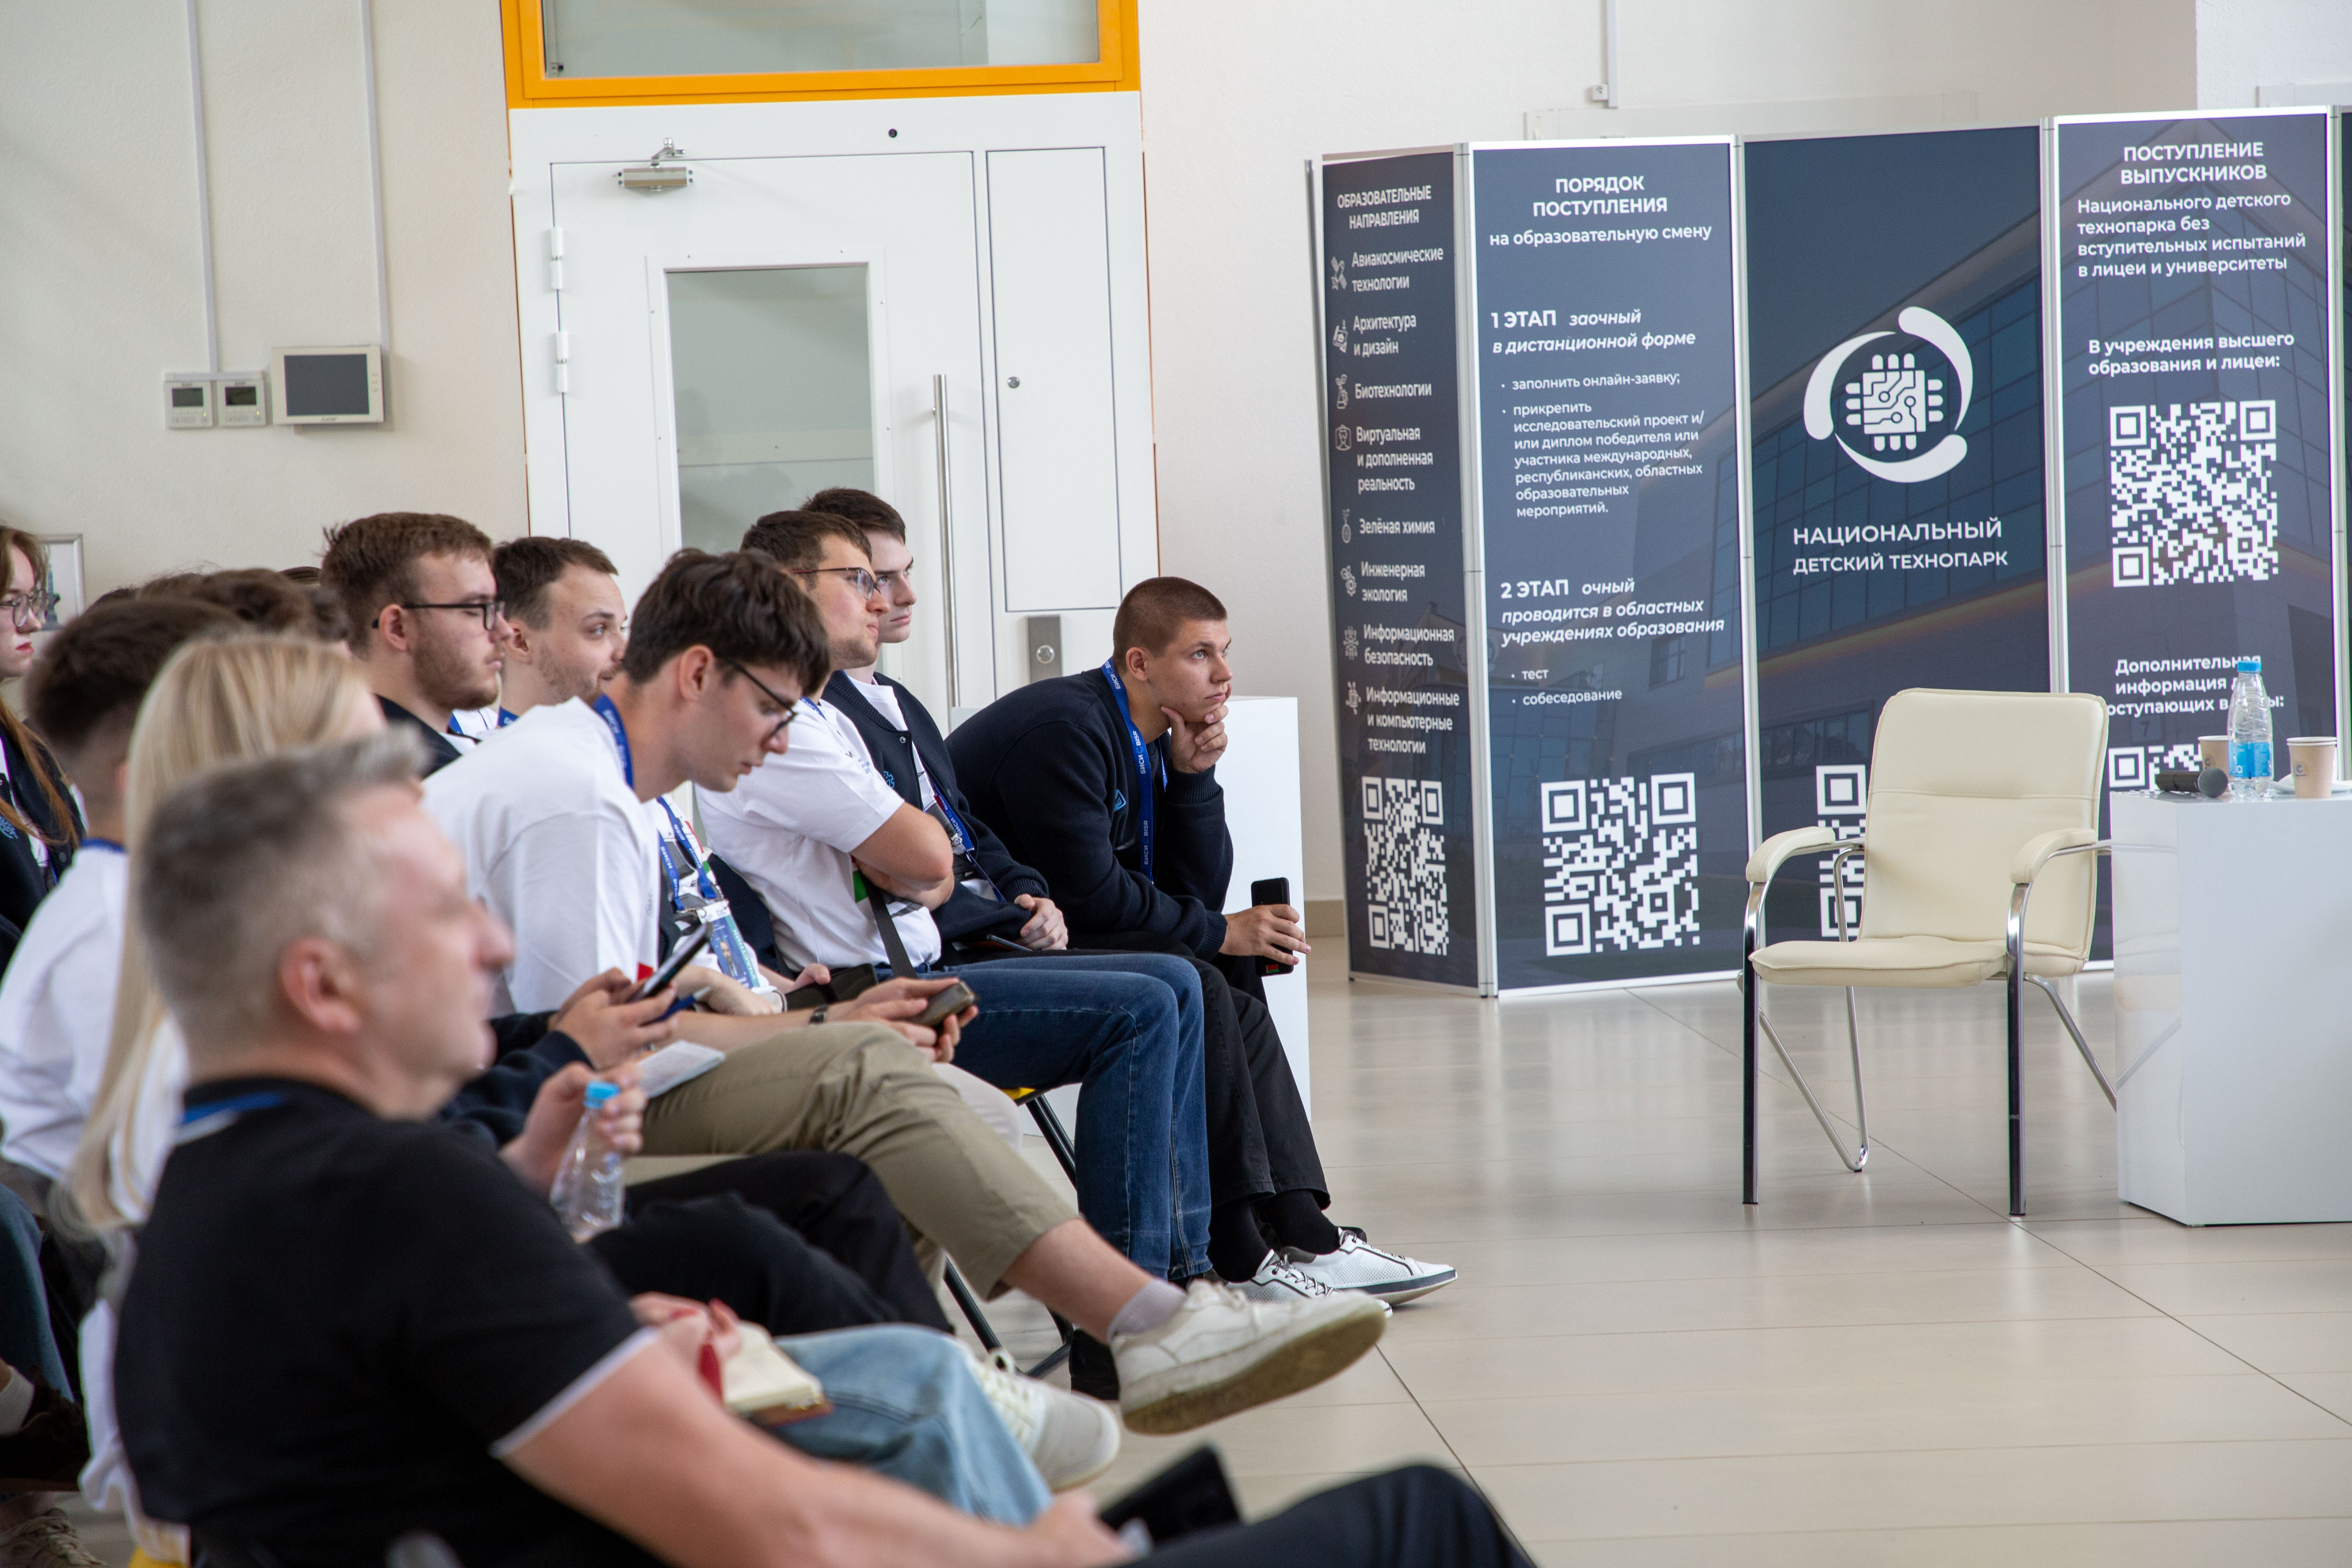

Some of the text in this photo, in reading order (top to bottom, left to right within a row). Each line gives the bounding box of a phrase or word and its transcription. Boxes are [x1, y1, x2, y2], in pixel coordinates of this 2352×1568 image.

[2124, 142, 2263, 162] ПОСТУПЛЕНИЕ
[2121, 165, 2267, 184] ВЫПУСКНИКОВ
[1556, 175, 1645, 194] ПОРЯДОК
[1337, 185, 1432, 208] ОБРАЗОВАТЕЛЬНЫЕ
[2078, 194, 2291, 214] Национального детского
[1533, 197, 1667, 217] ПОСТУПЛЕНИЯ
[1349, 208, 1419, 229] НАПРАВЛЕНИЯ
[2077, 215, 2210, 236] технопарка без
[1490, 226, 1712, 248] на образовательную смену
[2078, 233, 2306, 258] вступительных испытаний
[1352, 248, 1444, 267] Авиакосмические
[2079, 257, 2287, 278] в лицеи и университеты
[1352, 276, 1409, 292] технологии
[1353, 315, 1417, 334] Архитектура
[1491, 308, 1642, 328] 1 ЭТАП заочный
[1354, 338, 1399, 357] и дизайн
[1493, 332, 1696, 355] в дистанционной форме
[2089, 334, 2294, 357] В учреждения высшего
[2089, 356, 2280, 377] образования и лицеи:
[1355, 383, 1432, 399] Биотехнологии
[1512, 373, 1680, 390] заполнить онлайн-заявку;
[1513, 403, 1592, 418] прикрепить
[1514, 410, 1705, 432] исследовательский проект и/
[1356, 426, 1421, 445] Виртуальная
[1514, 431, 1699, 450] или диплом победителя или
[1357, 452, 1433, 468] и дополненная
[1514, 448, 1692, 469] участника международных,
[1516, 464, 1703, 486] республиканских, областных
[1358, 478, 1415, 494] реальность
[1516, 486, 1629, 502] образовательных
[1516, 501, 1608, 519] мероприятий.
[1359, 518, 1435, 534] Зелёная химия
[1794, 517, 2002, 546] НАЦИОНАЛЬНЫЙ
[1361, 562, 1425, 581] Инженерная
[1793, 551, 2008, 575] ДЕТСКИЙ ТЕХНОПАРК
[1362, 589, 1408, 602] экология
[1501, 578, 1635, 599] 2 ЭТАП очный
[1502, 600, 1704, 626] проводится в областных
[1364, 624, 1455, 643] Информационная
[1501, 619, 1724, 648] учреждениях образования
[1364, 647, 1433, 666] безопасность
[1522, 669, 1549, 680] тест
[1366, 686, 1460, 707] Информационные
[2116, 678, 2226, 696] информация
[1522, 690, 1623, 705] собеседование
[2107, 698, 2229, 718] оступающих в
[1367, 714, 1453, 733] и компьютерные
[1133, 730, 1141, 746] BISR
[1368, 738, 1426, 753] технологии
[950, 818, 963, 836] БИСИ
